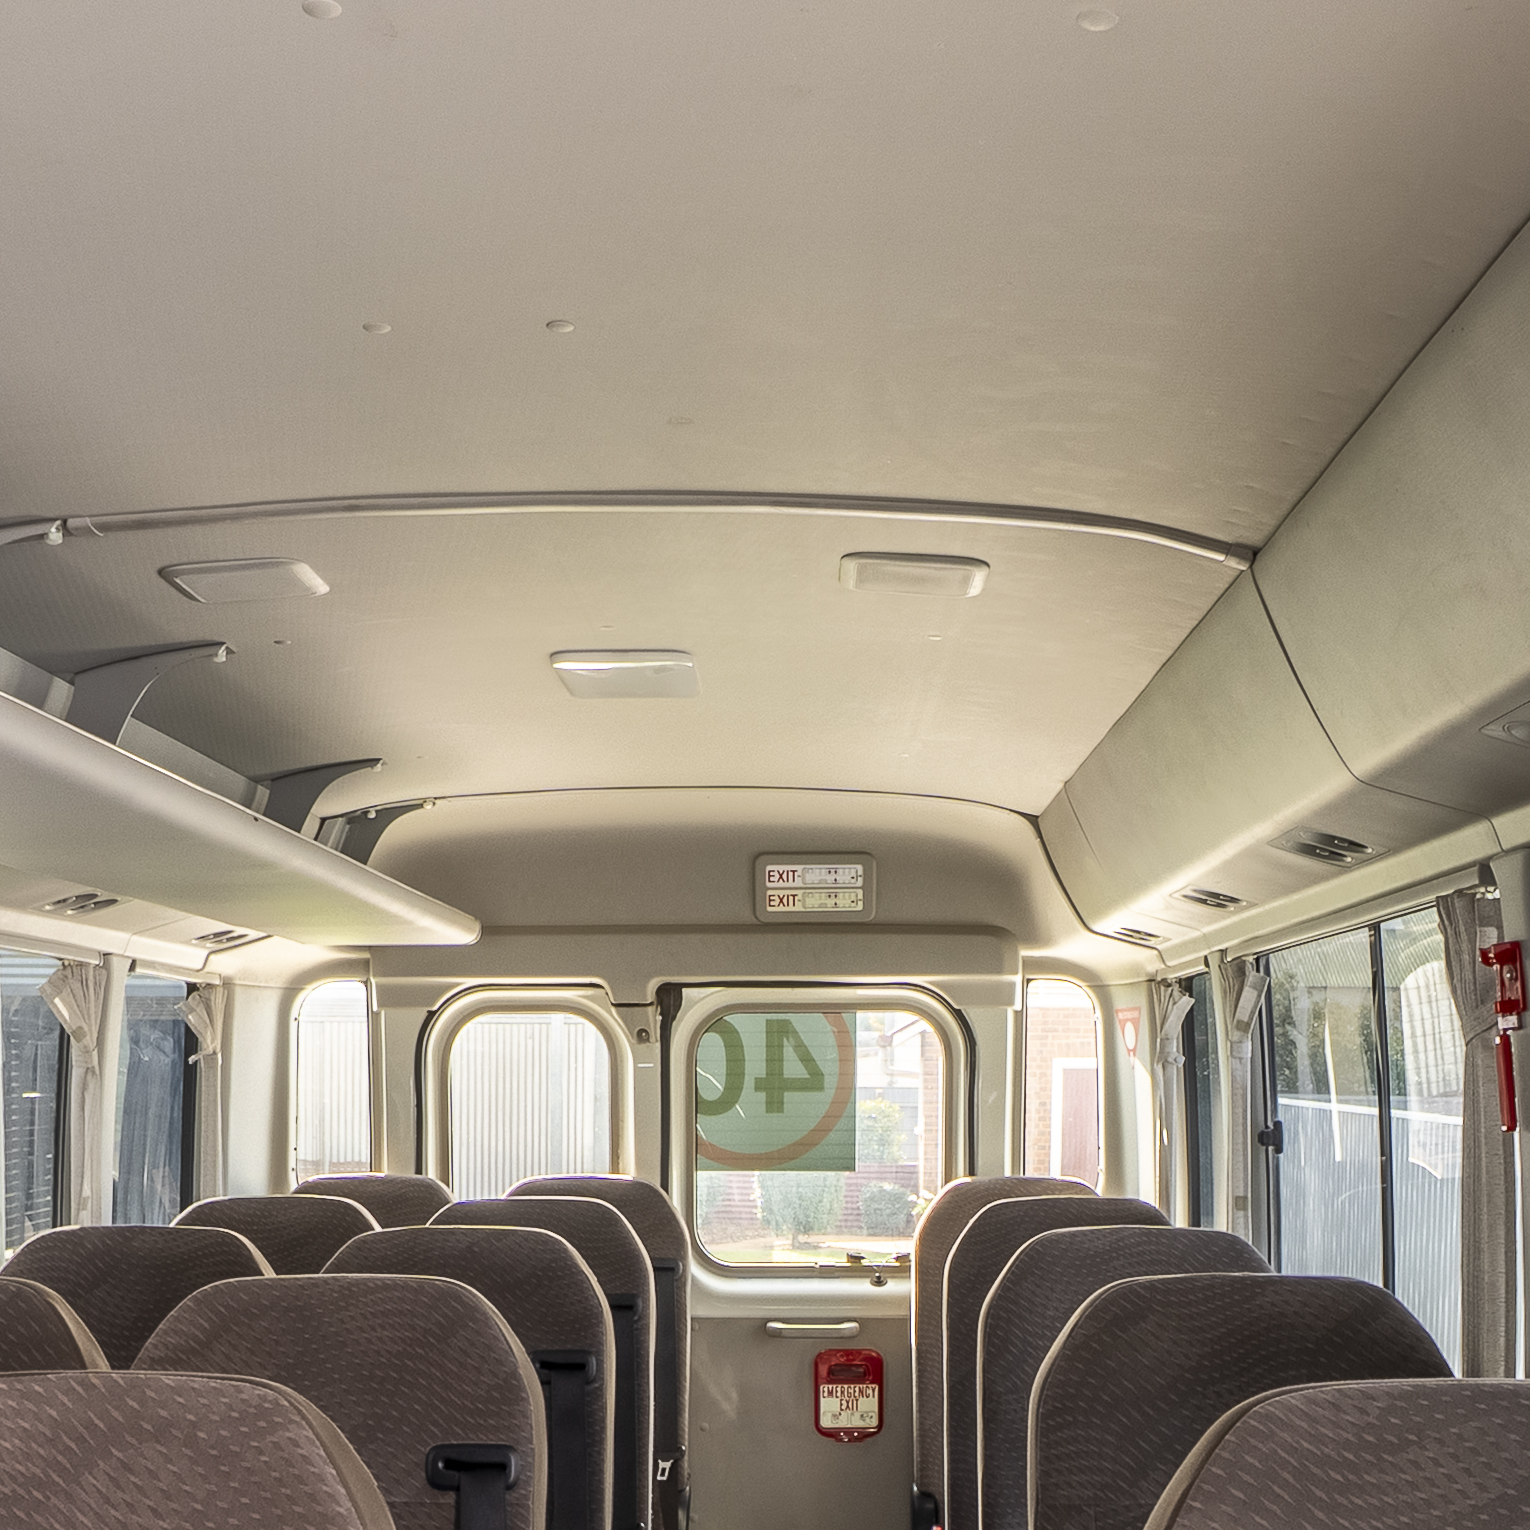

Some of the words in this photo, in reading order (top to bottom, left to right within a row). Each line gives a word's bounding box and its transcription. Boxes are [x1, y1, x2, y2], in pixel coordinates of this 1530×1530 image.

[767, 869, 798, 883] EXIT
[767, 894, 798, 907] EXIT
[822, 1385, 877, 1399] EMERGENCY
[839, 1399, 859, 1412] EXIT
